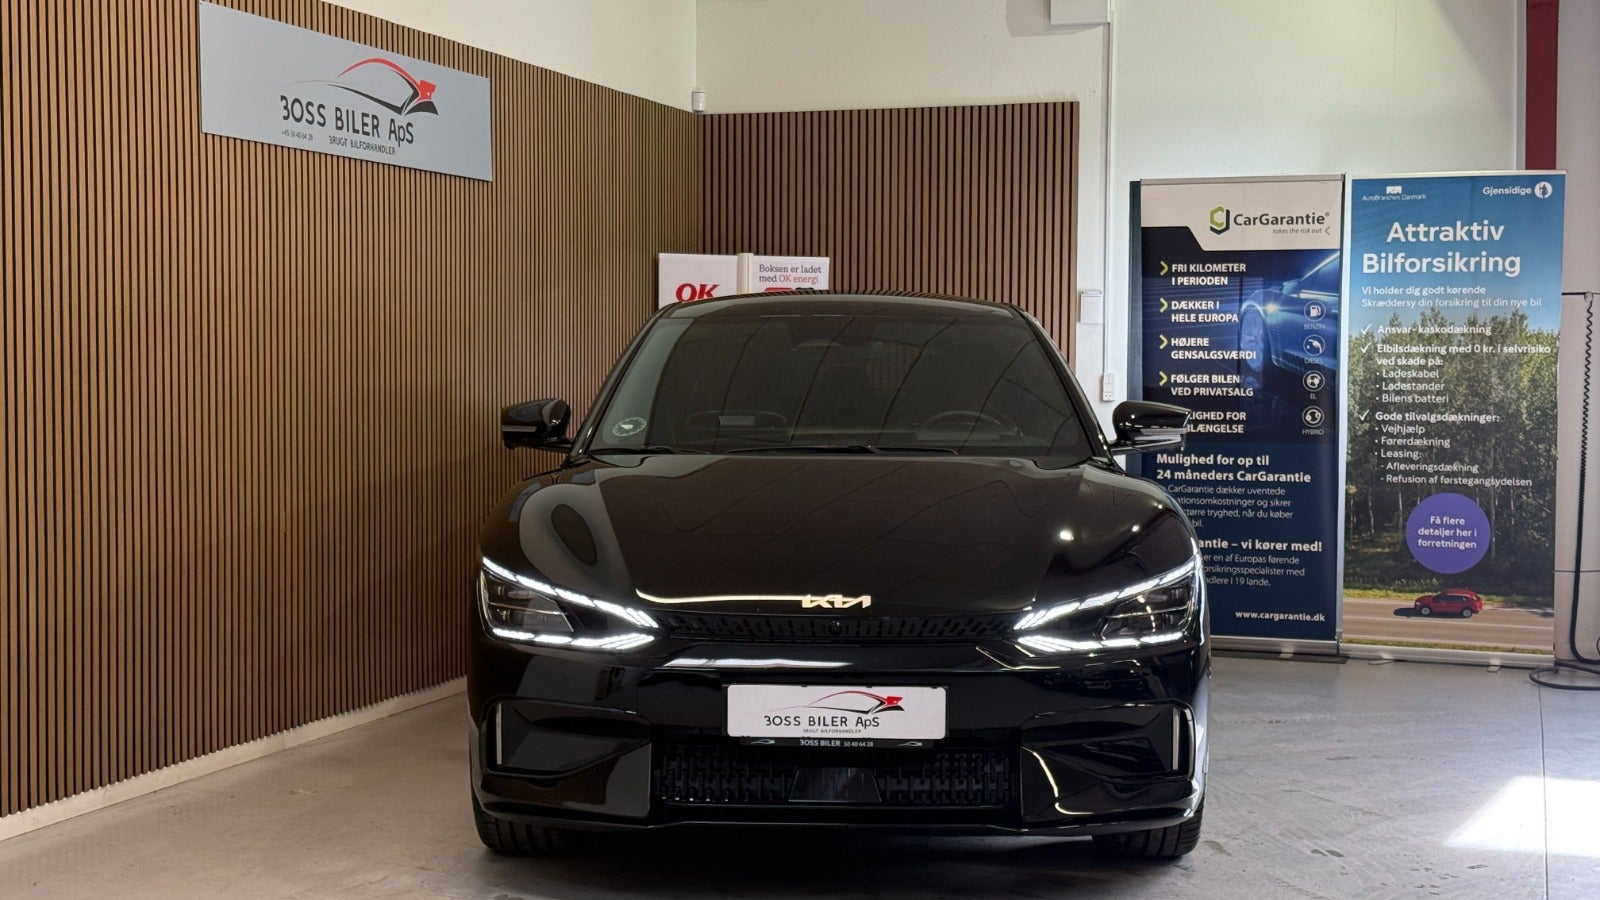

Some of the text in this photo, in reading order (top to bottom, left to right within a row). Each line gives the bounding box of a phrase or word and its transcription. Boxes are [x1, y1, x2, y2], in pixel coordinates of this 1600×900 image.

[335, 106, 380, 138] BILER
[388, 118, 414, 147] ApS
[350, 138, 396, 156] BILFORHANDLER
[1482, 185, 1532, 197] Gjensidige
[1386, 219, 1505, 243] Attraktiv
[759, 264, 789, 273] Boksen
[800, 265, 822, 274] ladet
[1171, 263, 1246, 273] FRI KILOMETER
[1362, 251, 1521, 278] Bilforsikring
[759, 274, 819, 284] med OK energi
[1177, 276, 1228, 286] PERIODEN
[675, 283, 720, 303] OK
[1361, 286, 1486, 296] Vi holder dig godt kørende
[1171, 301, 1214, 310] DÆKKER
[1361, 298, 1541, 309] Skræddersy din forsikring til din nye bil
[1171, 313, 1239, 323] HELE EUROPA
[1418, 325, 1492, 336] kaskodækning
[1171, 337, 1209, 347] HØJERE
[1377, 344, 1447, 354] Elbilsdækning
[1449, 344, 1472, 353] med
[1473, 345, 1480, 353] 0
[1482, 344, 1495, 353] kr.
[1503, 344, 1551, 354] selvrisiko
[1171, 350, 1256, 360] GENSALGSVÆRDI
[1376, 357, 1443, 367] ved skade på:
[1382, 369, 1439, 378] Ladeskabel
[1170, 374, 1240, 384] FØLGER BILEN
[1382, 382, 1445, 391] Ladestander
[1170, 387, 1254, 397] VED PRIVATSALG
[1382, 394, 1449, 404] Bilens batteri
[1226, 411, 1247, 420] FOR
[1375, 412, 1500, 423] Gode tilvalgsdækninger:
[1381, 425, 1425, 435] Vejhjælp
[1381, 437, 1451, 448] Førerdækning
[1156, 453, 1270, 468] Mulighed for op til
[1386, 462, 1479, 473] Afleveringsdækning
[1156, 469, 1311, 483] 24 måneders CarGarantie
[1386, 475, 1532, 488] Refusion af førstegangsydelsen
[1168, 484, 1286, 496] CarGarantie dækker uventede
[1257, 499, 1268, 507] og
[1207, 509, 1241, 519] tryghed,
[1242, 510, 1255, 518] når
[1257, 510, 1268, 518] du
[1270, 510, 1293, 519] køber
[1430, 515, 1465, 525] Få flere
[1417, 528, 1454, 538] detaljer
[1456, 529, 1473, 537] her
[1241, 539, 1252, 550] vi
[1255, 540, 1288, 551] kører
[1291, 541, 1322, 552] med!
[1417, 539, 1477, 550] forretningen
[1234, 554, 1267, 563] Europas
[1268, 555, 1300, 564] førende
[1286, 568, 1305, 576] med
[1246, 578, 1271, 586] lande.
[802, 594, 871, 608] KIA
[1235, 610, 1326, 622] www.cargarantie.dk
[808, 716, 848, 727] BILER
[855, 717, 880, 730] ApS
